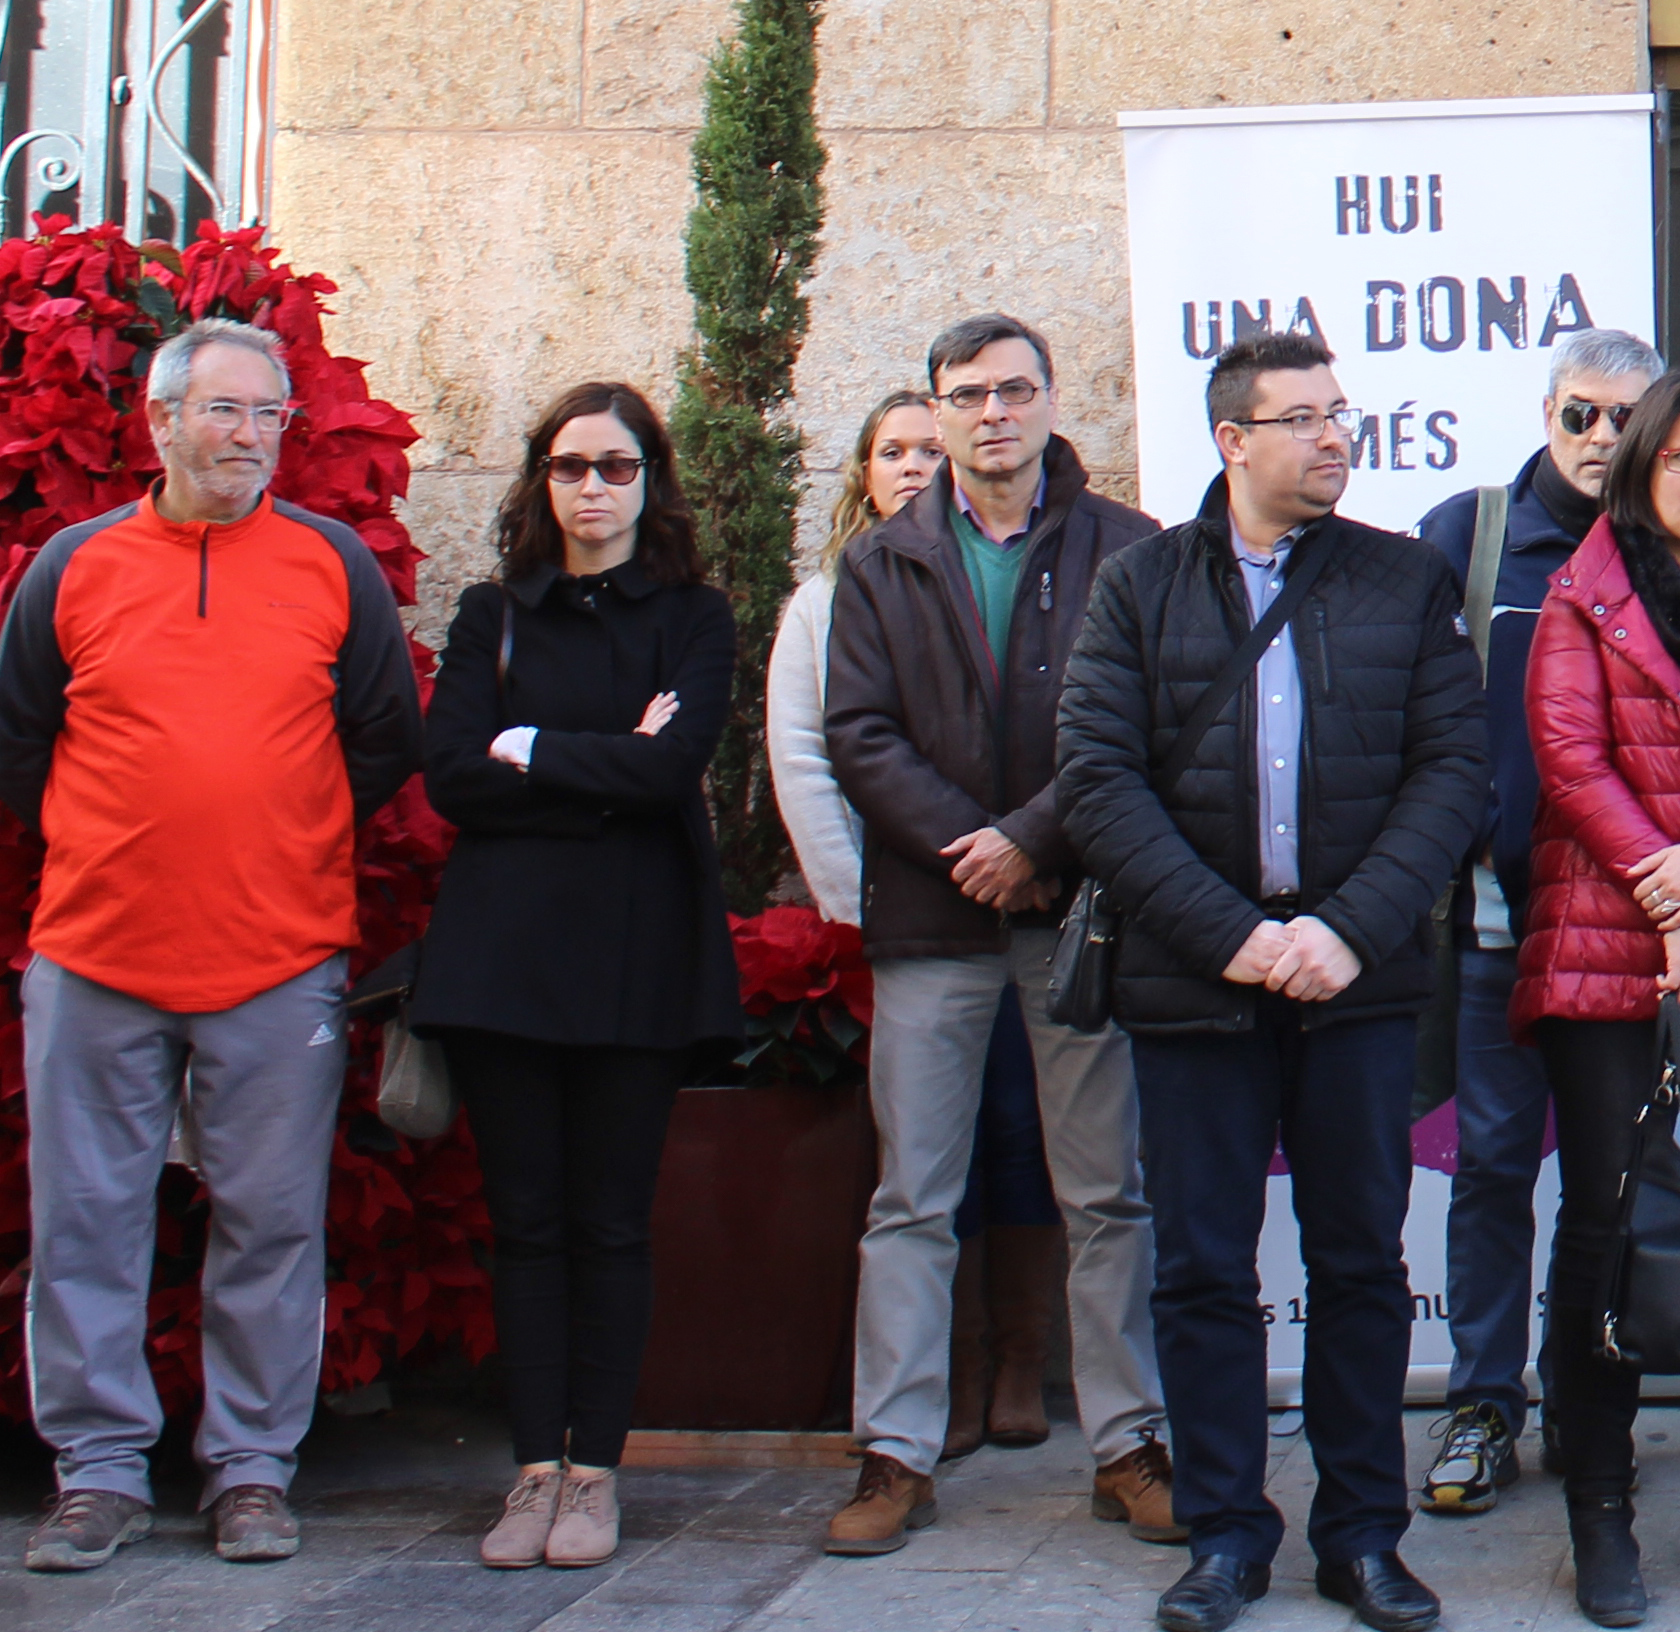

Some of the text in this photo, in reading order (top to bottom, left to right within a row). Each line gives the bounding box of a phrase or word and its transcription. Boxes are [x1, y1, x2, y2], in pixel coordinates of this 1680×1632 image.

[1335, 173, 1443, 235] HUI
[1182, 273, 1595, 360] UNA DONA
[1350, 400, 1459, 471] MÉS
